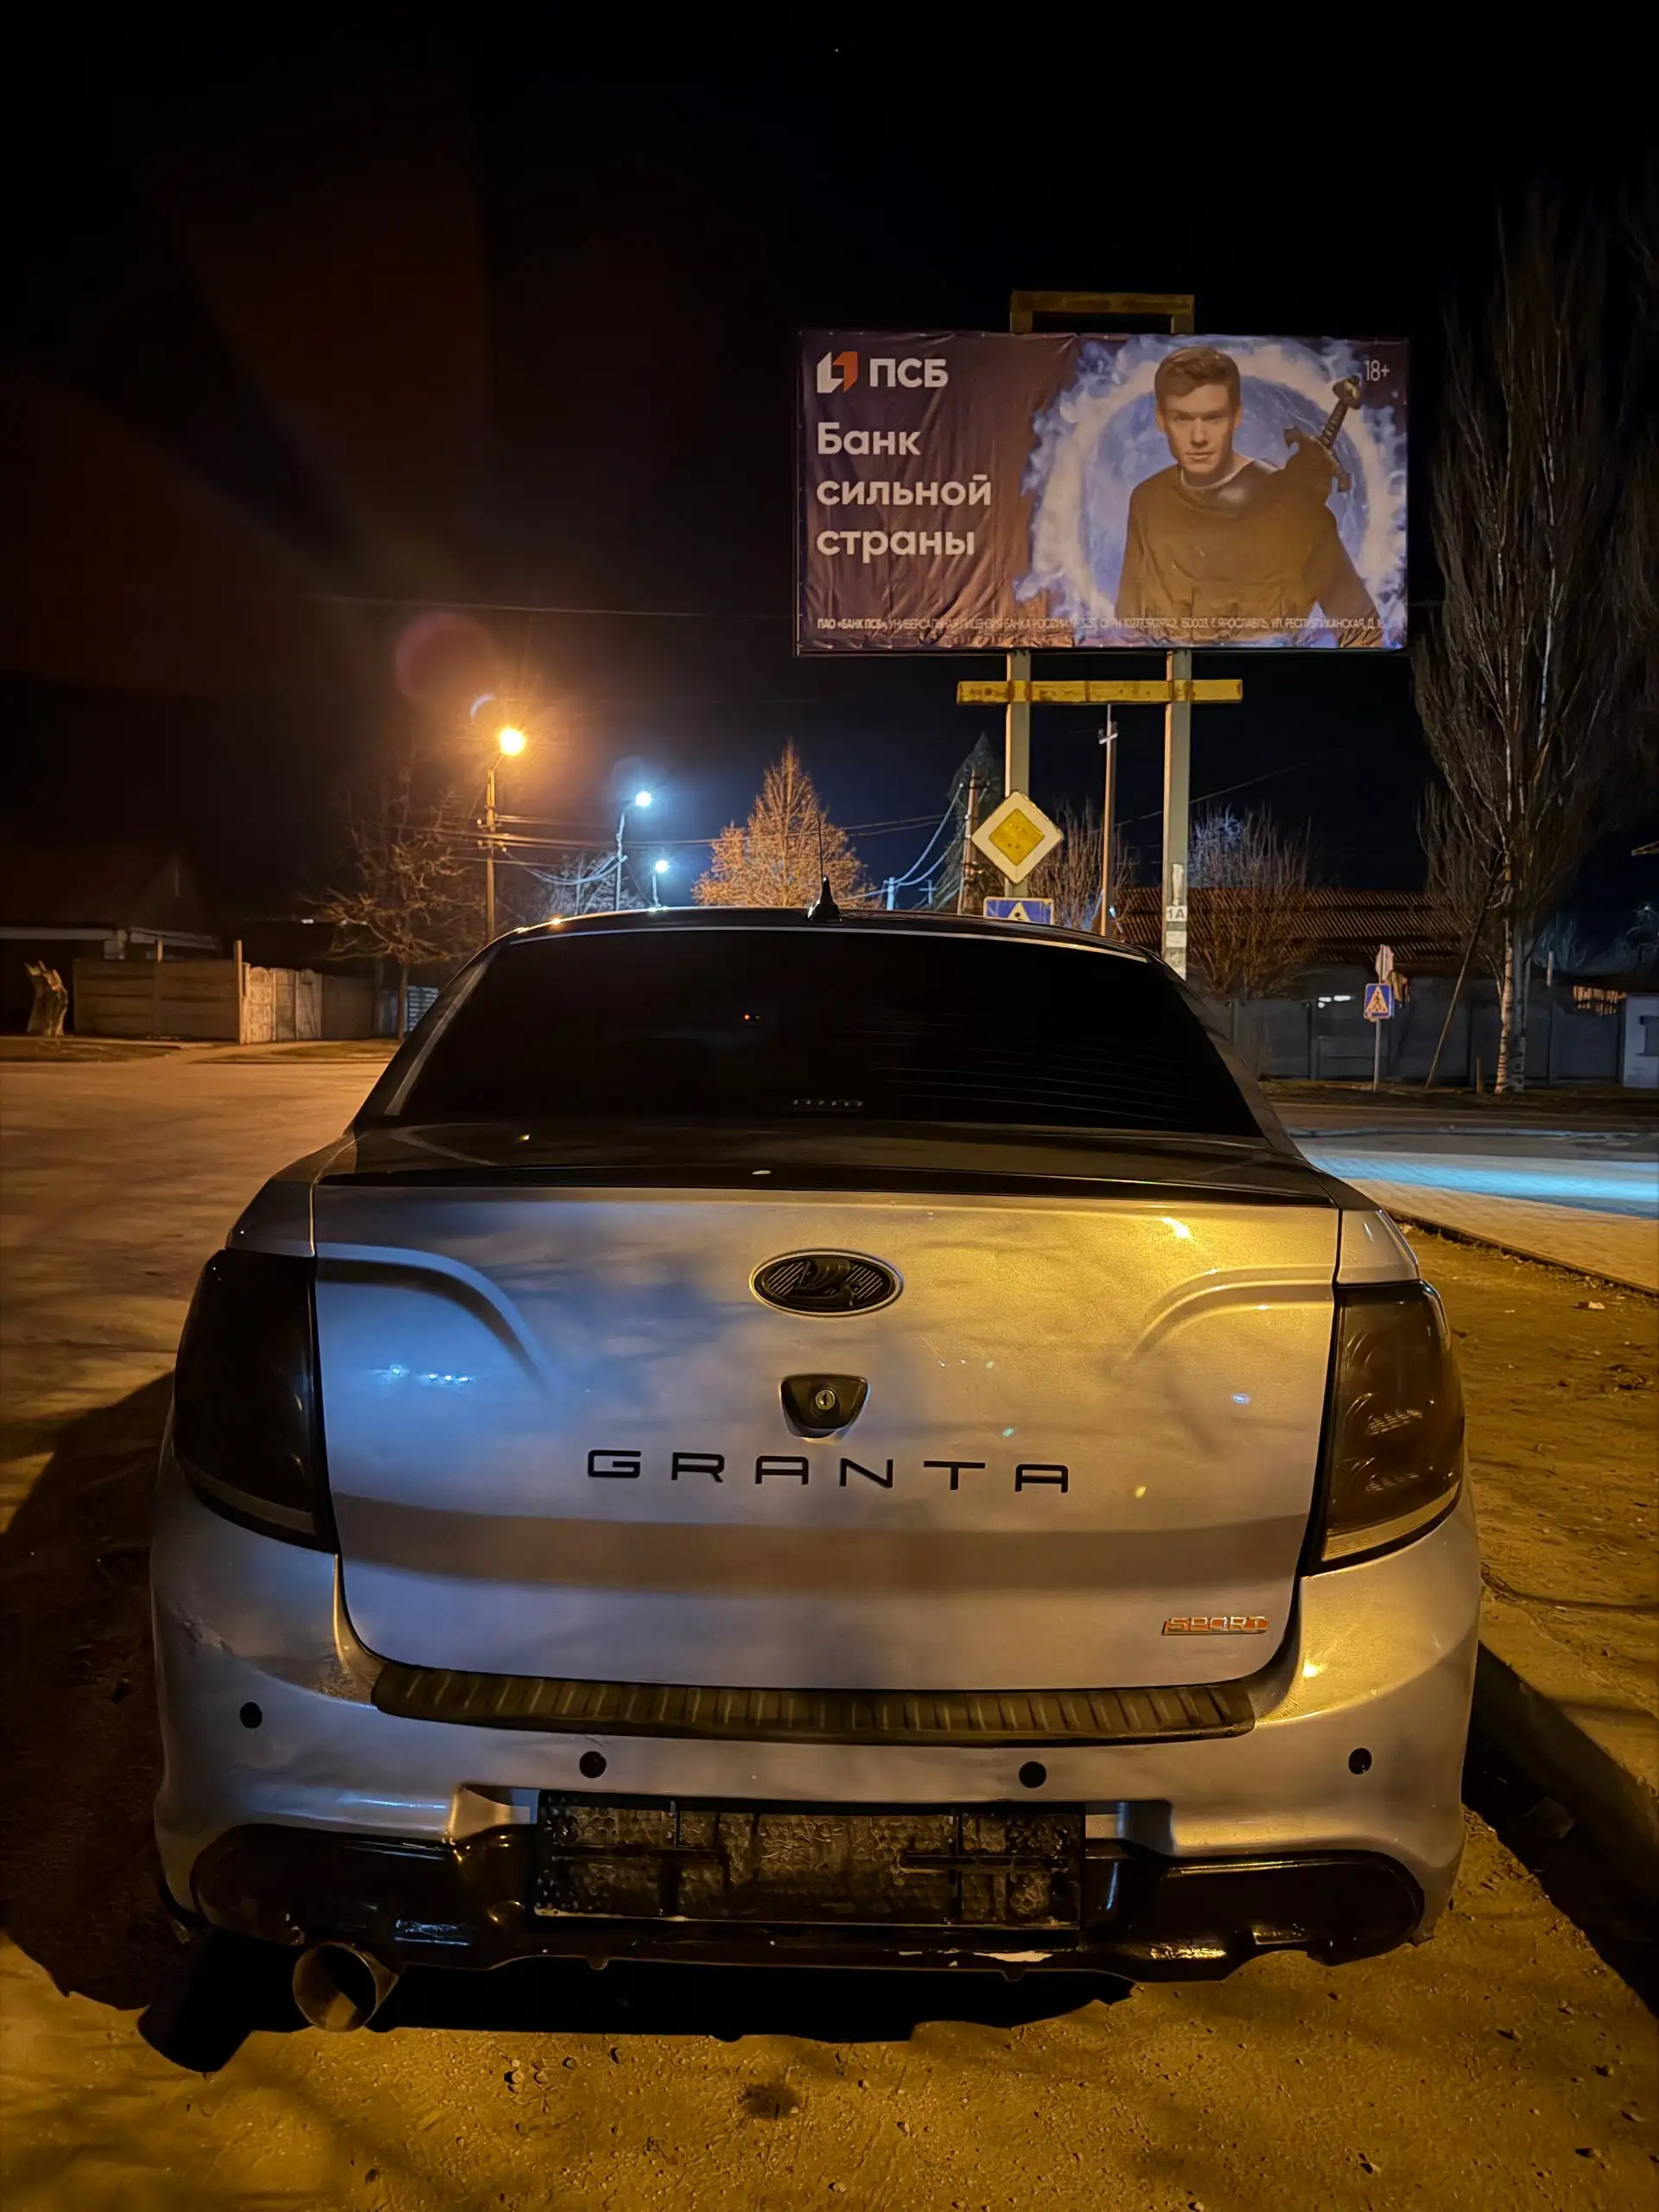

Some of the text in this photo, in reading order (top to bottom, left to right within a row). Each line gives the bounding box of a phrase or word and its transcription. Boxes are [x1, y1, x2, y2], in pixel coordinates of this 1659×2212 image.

[869, 358, 949, 388] ПСБ
[1364, 359, 1390, 381] 18+
[817, 422, 921, 455] Банк
[816, 474, 991, 506] сильной
[816, 531, 976, 563] страны
[817, 618, 836, 629] ПАО
[837, 618, 863, 629] «БАНК
[588, 1449, 1068, 1493] GRANTA
[1166, 1616, 1268, 1633] SPORT
